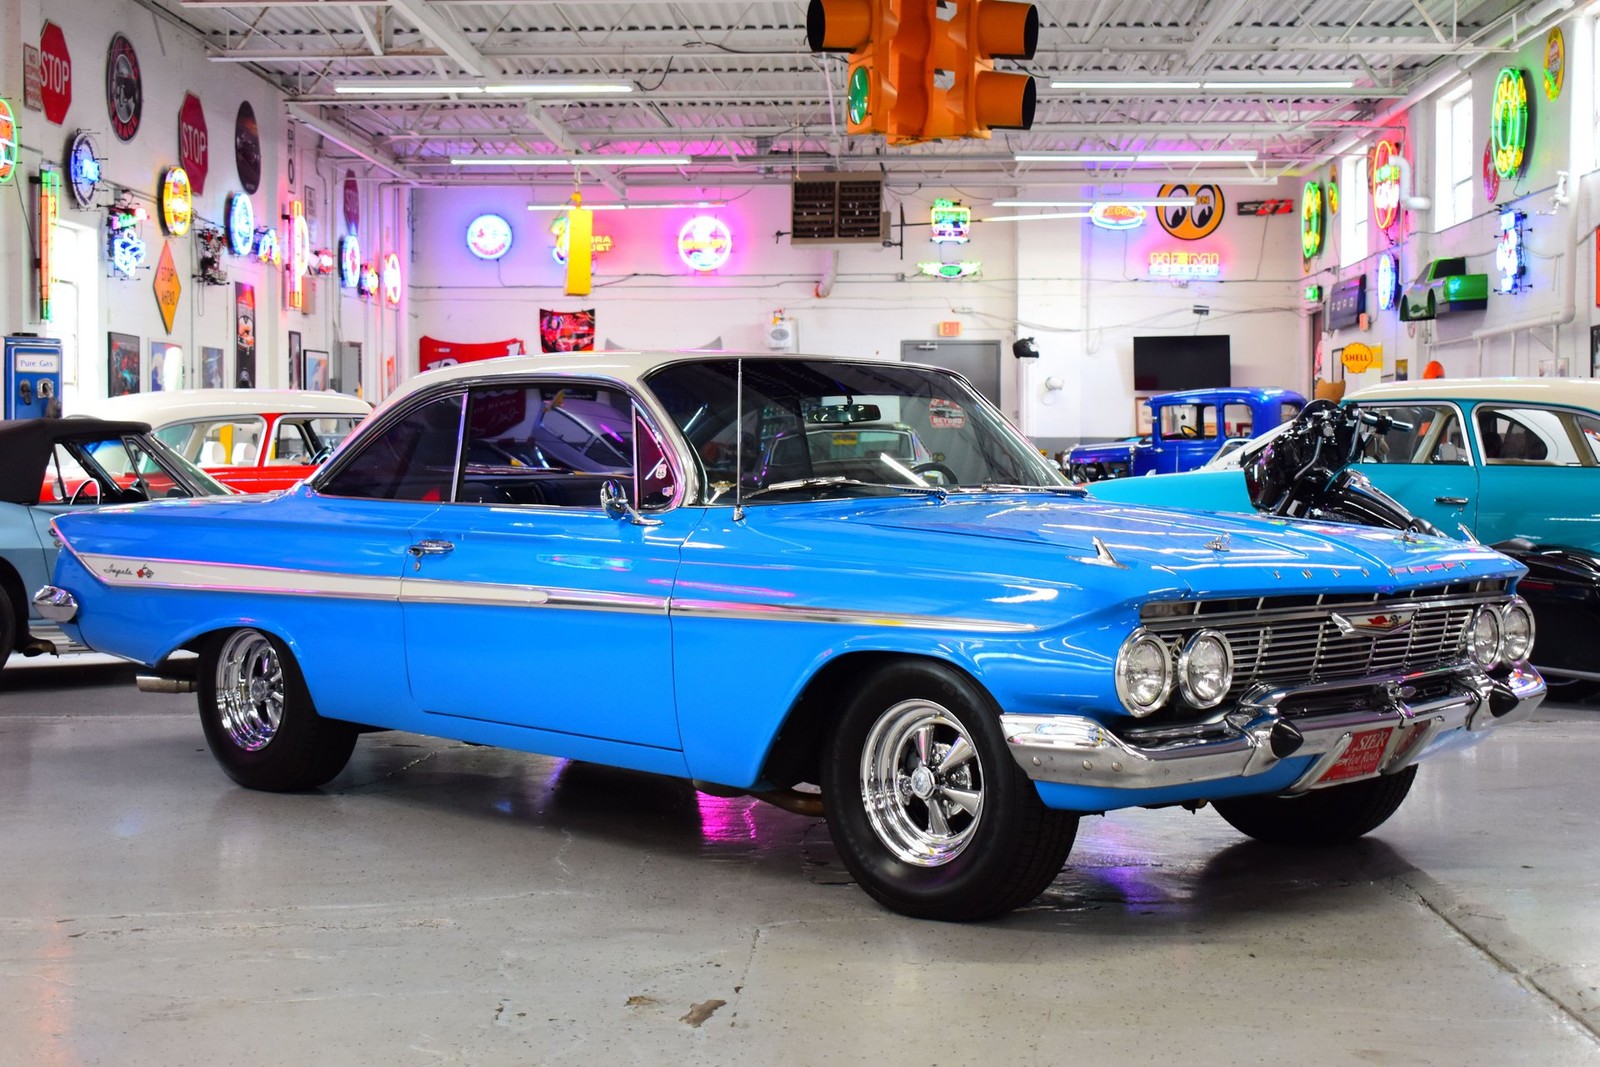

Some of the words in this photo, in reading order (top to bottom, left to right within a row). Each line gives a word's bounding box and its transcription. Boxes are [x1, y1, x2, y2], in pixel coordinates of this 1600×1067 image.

[41, 51, 70, 96] STOP
[182, 121, 207, 166] STOP
[1151, 252, 1219, 265] HEMI
[1331, 297, 1354, 312] FORD
[1345, 354, 1368, 362] SHELL
